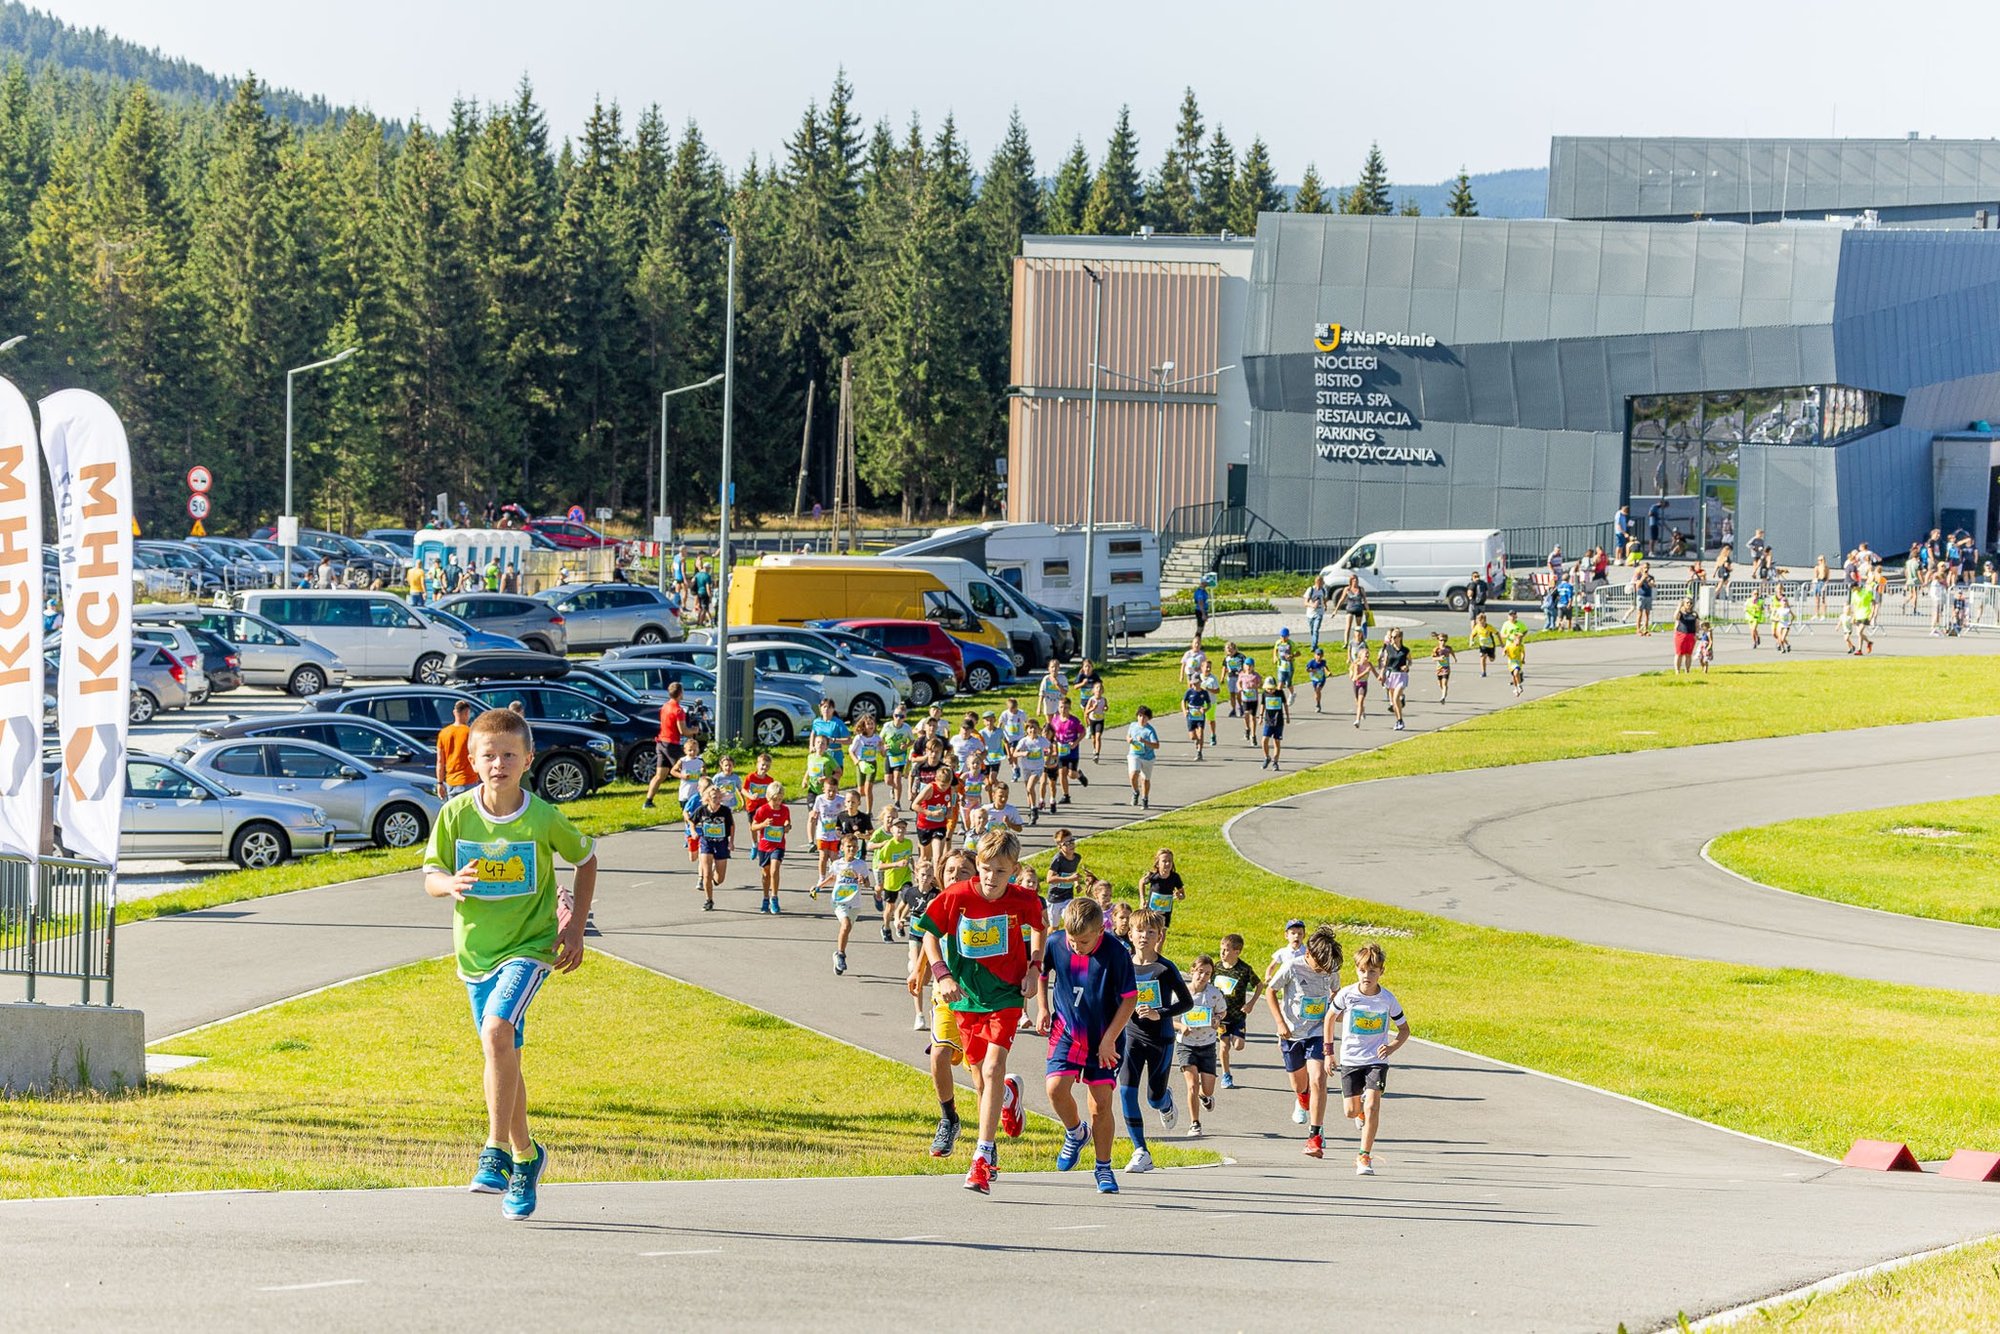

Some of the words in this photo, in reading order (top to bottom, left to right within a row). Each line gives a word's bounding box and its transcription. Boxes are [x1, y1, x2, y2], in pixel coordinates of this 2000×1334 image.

[1340, 330, 1437, 347] #NaPolanie
[1313, 356, 1378, 370] NOCLEGI
[1315, 373, 1363, 387] BISTRO
[1316, 391, 1364, 406] STREFA
[1367, 393, 1392, 407] SPA
[1316, 409, 1412, 426] RESTAURACJA
[1316, 427, 1376, 441] PARKING
[1316, 444, 1437, 461] WYPOŻYCZALNIA
[191, 500, 206, 512] 50
[485, 862, 506, 877] 47
[971, 932, 988, 944] 62
[1073, 986, 1084, 1007] 7
